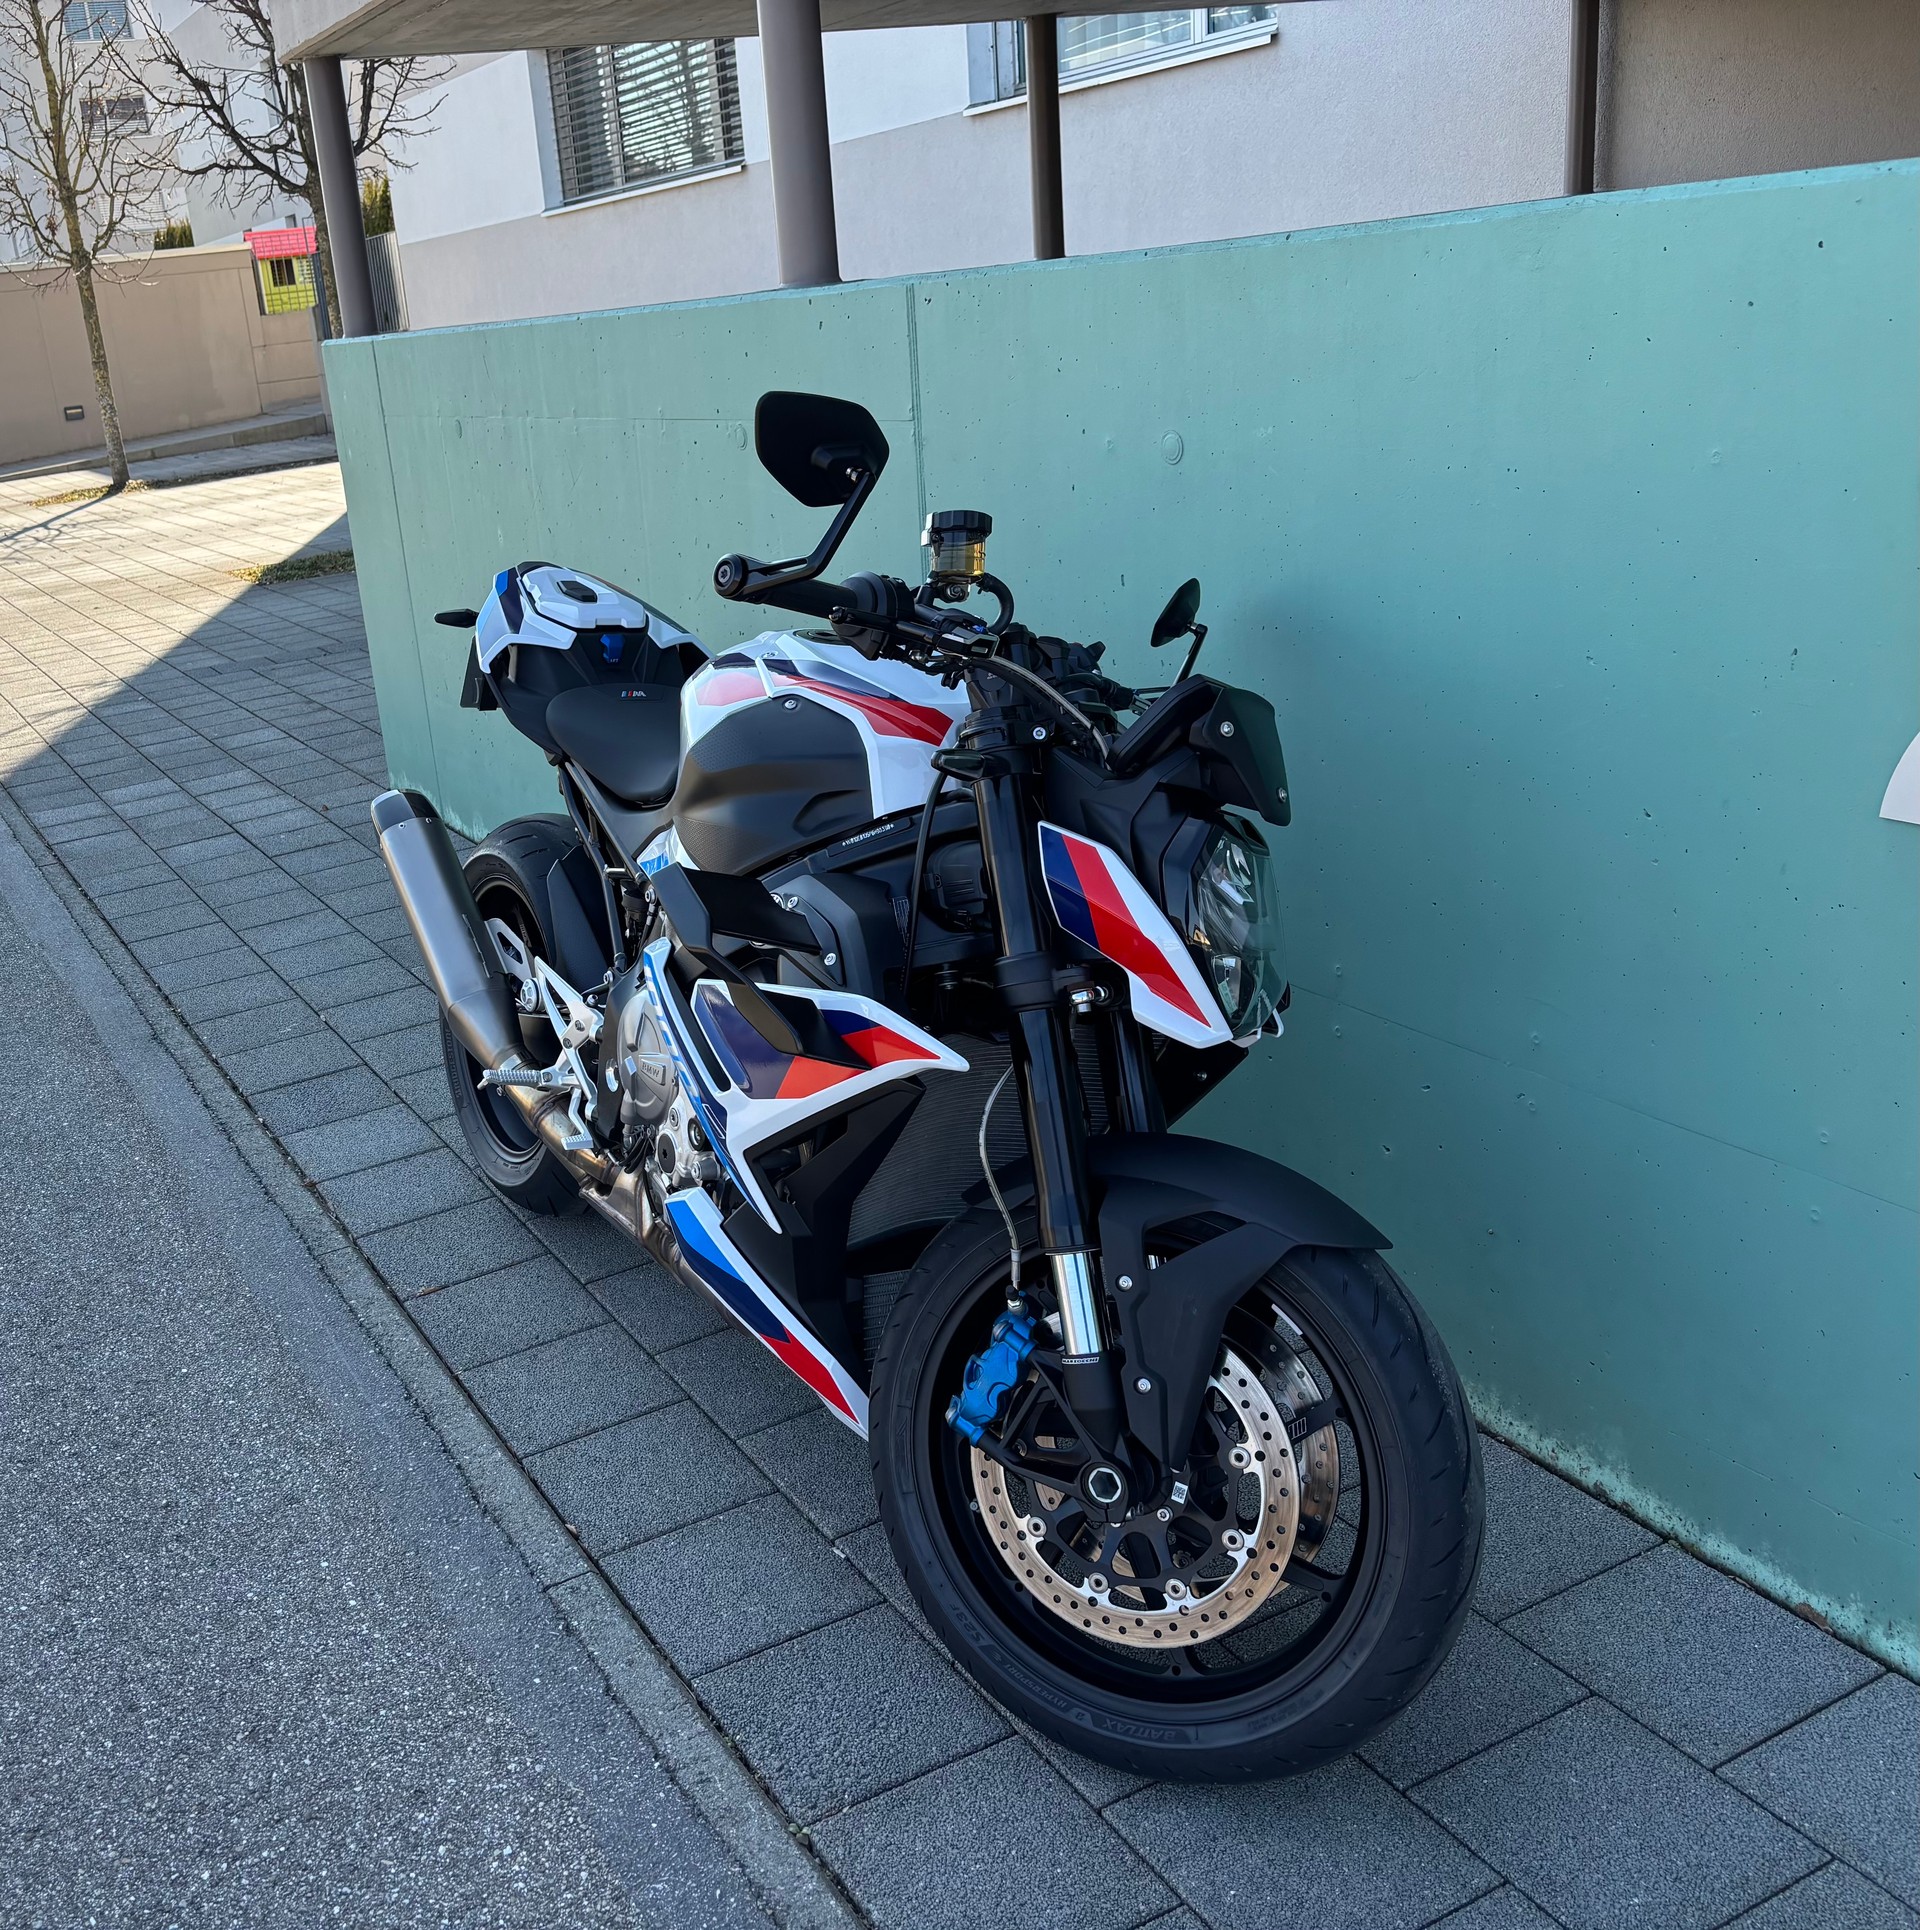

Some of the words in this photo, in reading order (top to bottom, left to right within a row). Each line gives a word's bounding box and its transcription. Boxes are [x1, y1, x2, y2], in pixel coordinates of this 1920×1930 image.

[641, 1061, 660, 1078] BMW
[949, 1603, 985, 1641] S23F
[1003, 1663, 1068, 1708] HYPERSPORT
[1102, 1718, 1177, 1741] BATTLAX
